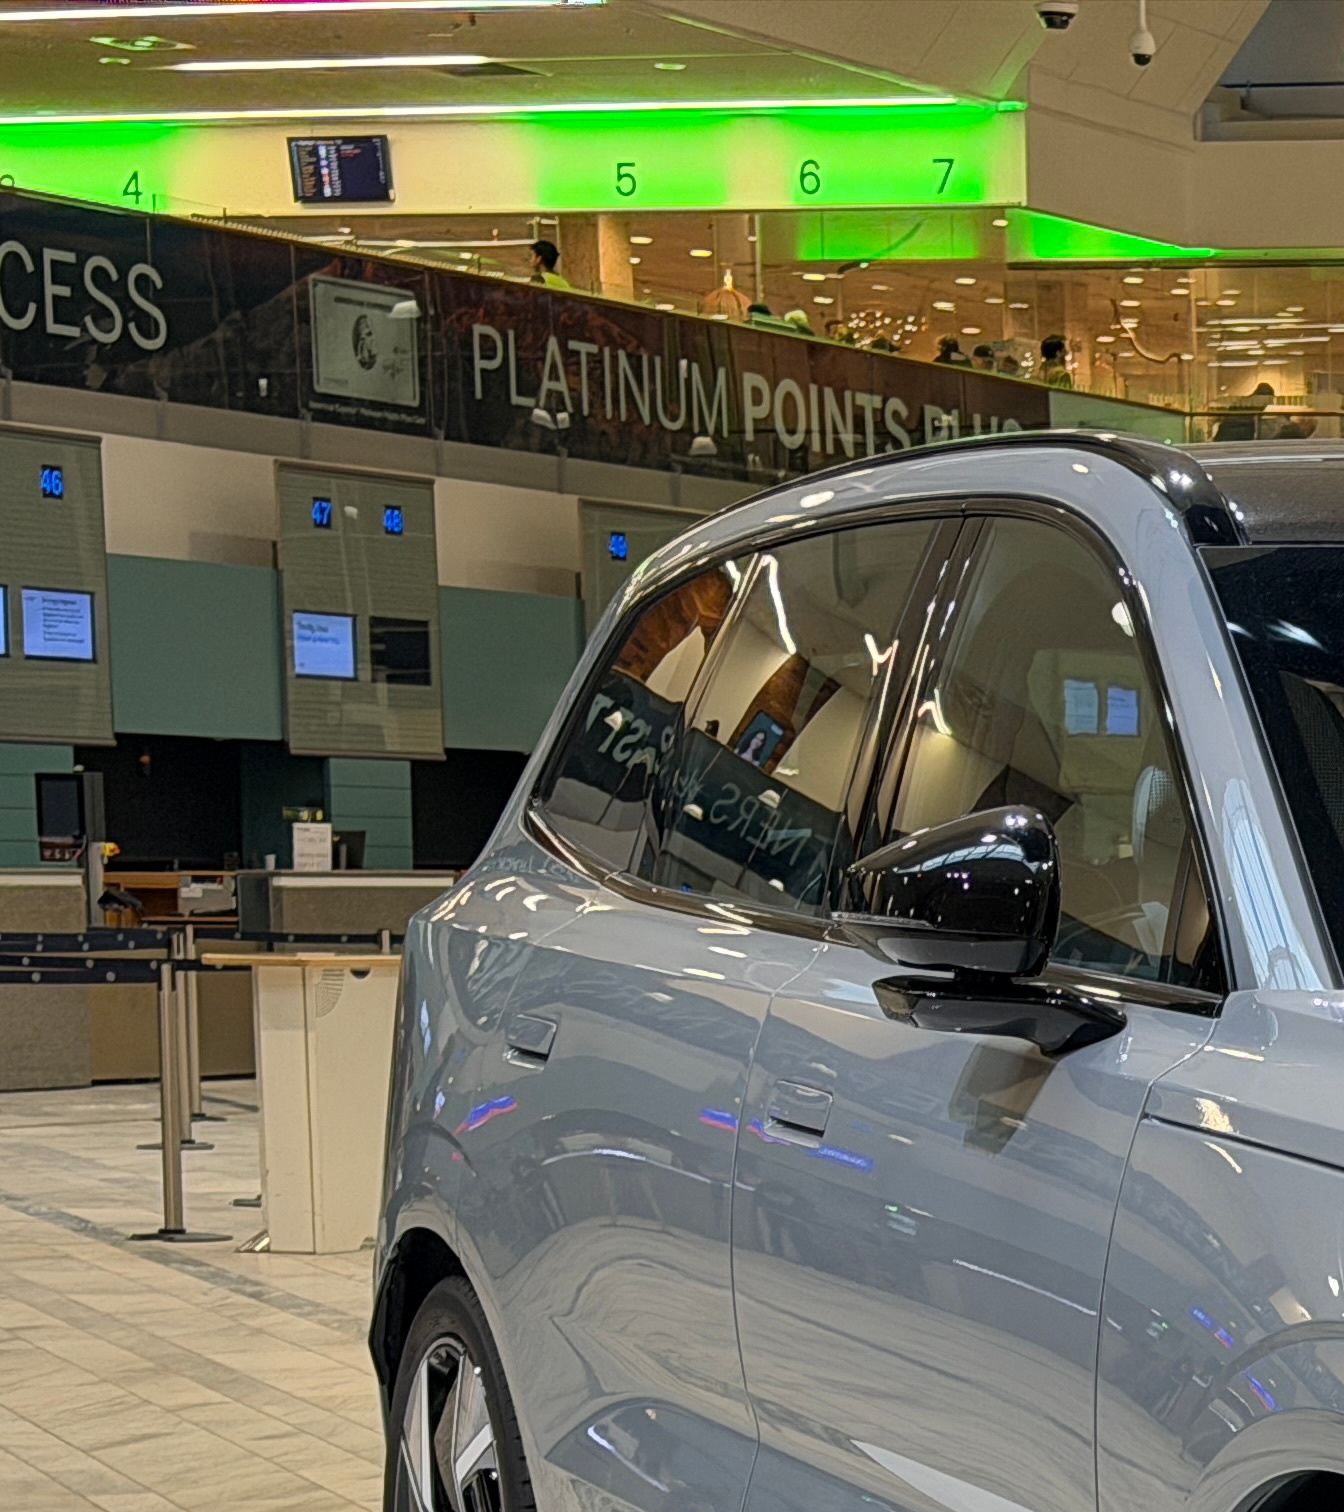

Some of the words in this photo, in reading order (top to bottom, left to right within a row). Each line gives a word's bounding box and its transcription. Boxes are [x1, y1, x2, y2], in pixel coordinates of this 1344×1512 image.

[122, 170, 143, 204] 4
[615, 162, 637, 197] 5
[799, 159, 821, 194] 6
[932, 158, 955, 194] 7
[472, 323, 730, 439] PLATINUM
[743, 371, 911, 458] POINTS
[923, 404, 1023, 444] PL
[312, 502, 332, 525] 47
